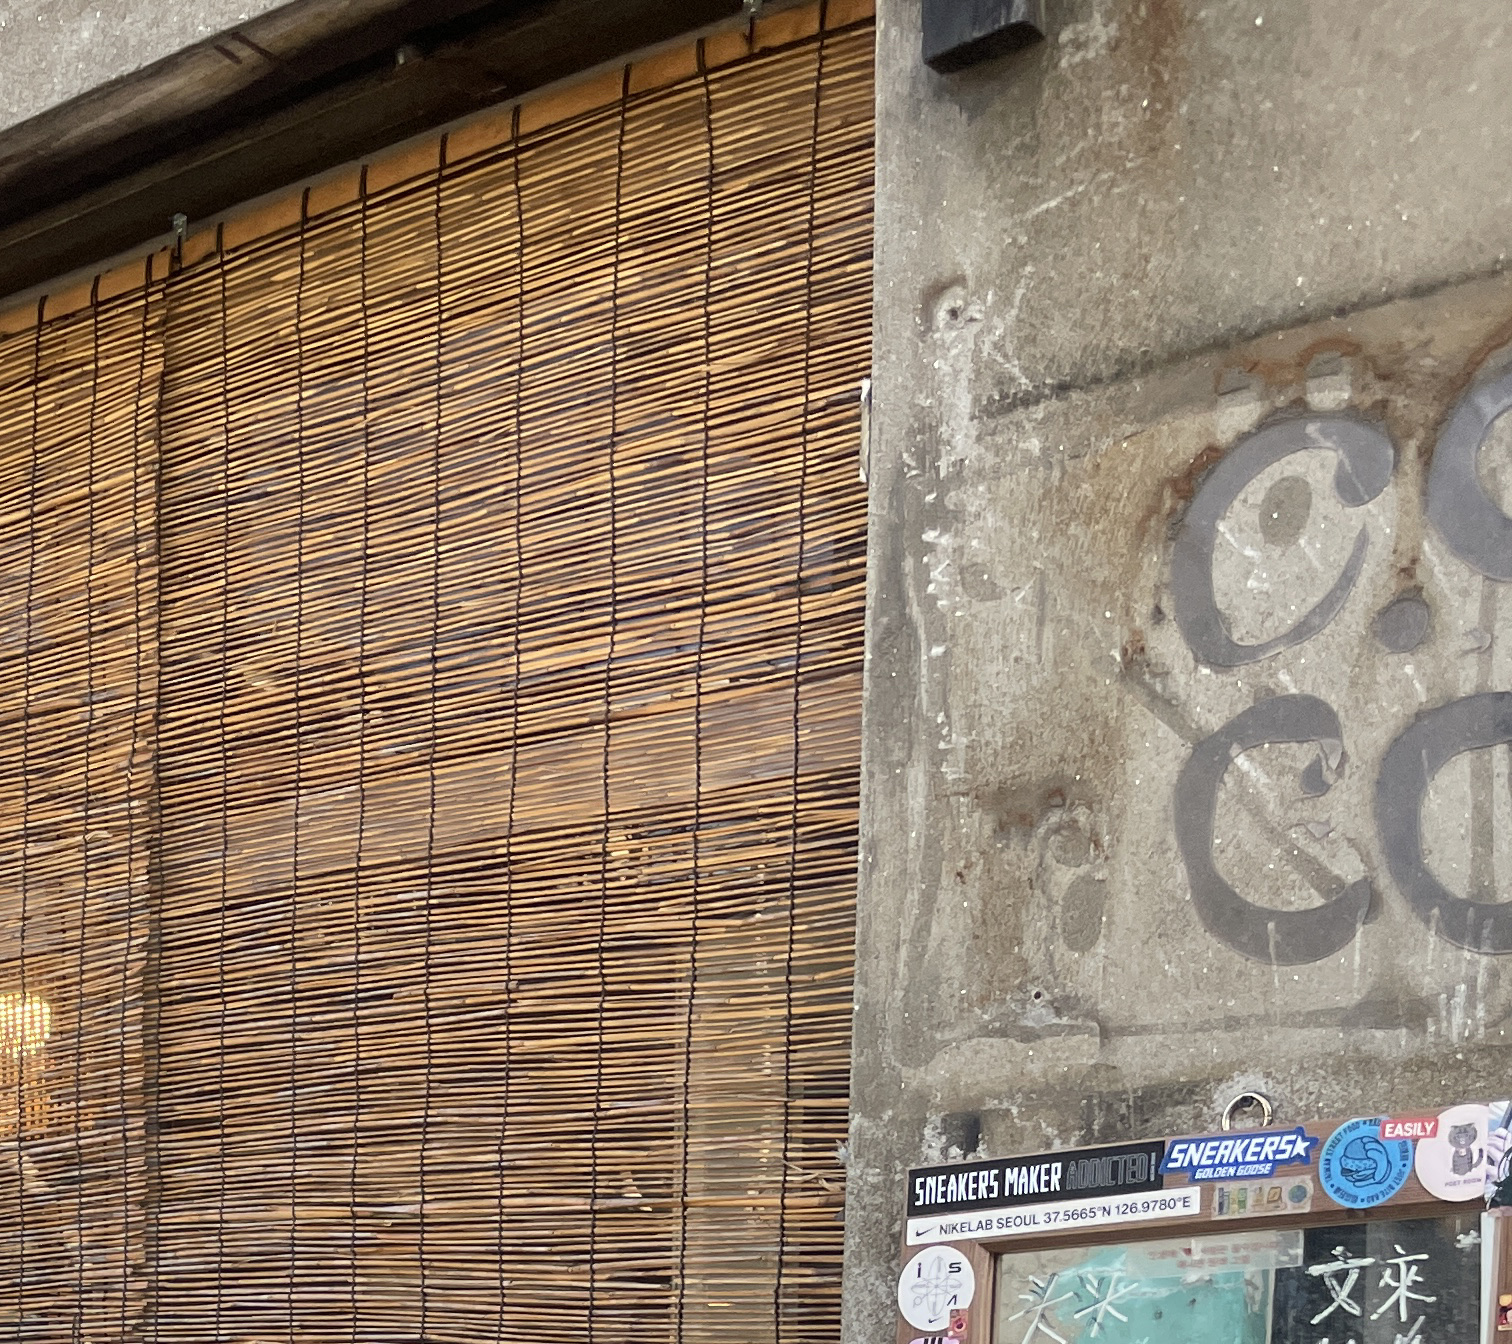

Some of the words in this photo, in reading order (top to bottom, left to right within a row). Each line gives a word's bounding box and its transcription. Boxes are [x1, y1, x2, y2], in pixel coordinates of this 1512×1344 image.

[1384, 1121, 1435, 1138] EASILY
[1167, 1135, 1296, 1169] SNEAKERS
[914, 1169, 1000, 1206] SNEAKERS
[1004, 1162, 1063, 1197] MAKER
[1066, 1152, 1148, 1191] ADDICTED
[1195, 1166, 1237, 1180] GOLDEN
[1237, 1162, 1273, 1176] GOOSE
[939, 1219, 993, 1236] NIKELAB
[996, 1213, 1040, 1229] SEOUL
[1043, 1205, 1112, 1224] 37.5665°N
[1115, 1195, 1192, 1214] 126.9780°E
